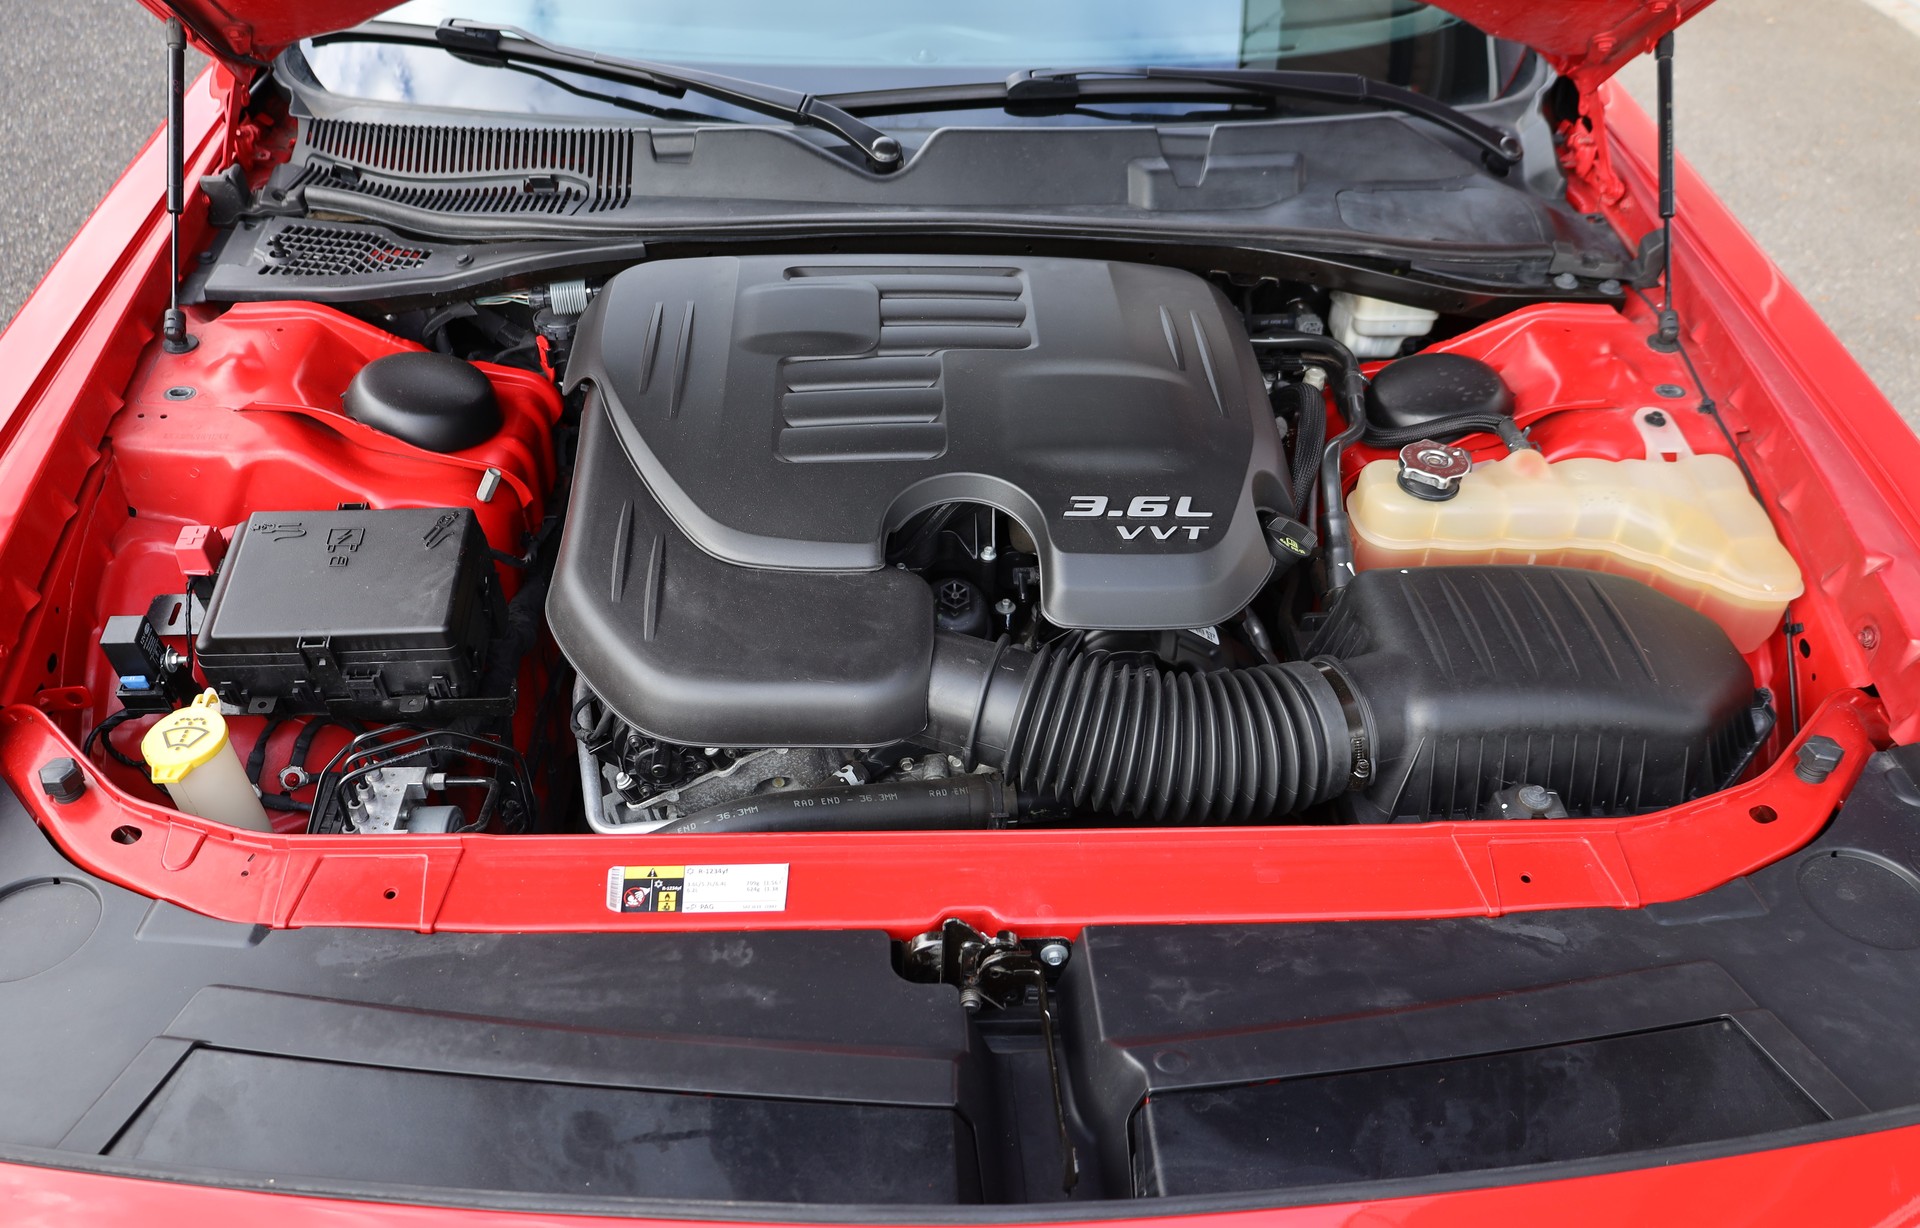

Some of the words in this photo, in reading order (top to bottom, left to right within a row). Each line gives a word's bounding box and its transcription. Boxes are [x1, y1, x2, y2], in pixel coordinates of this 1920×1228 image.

[1063, 495, 1213, 518] 3.6L
[1116, 525, 1210, 541] VVT
[793, 799, 814, 808] RAD
[820, 796, 841, 806] END
[859, 793, 898, 803] 36.3MM
[929, 789, 947, 798] RAD
[716, 805, 759, 822] 36.3MM
